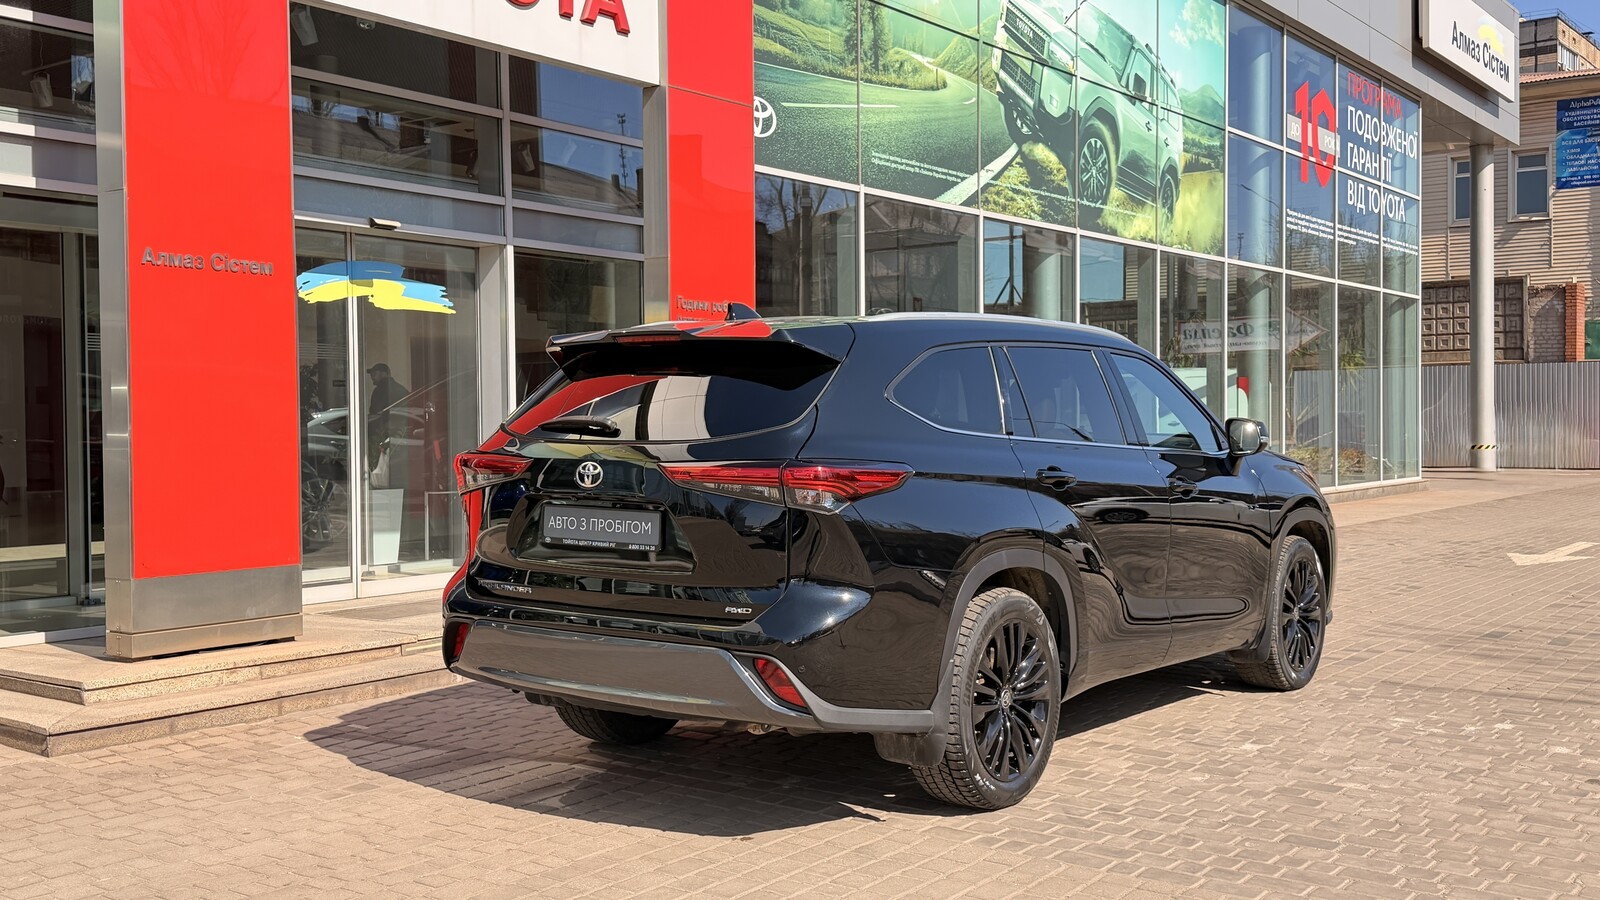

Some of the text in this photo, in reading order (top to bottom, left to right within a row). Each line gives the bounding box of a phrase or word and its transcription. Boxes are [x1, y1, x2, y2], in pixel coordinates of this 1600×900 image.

[1451, 20, 1510, 83] Алмаз Сістем
[1347, 71, 1402, 121] ПРОГРАМА
[1290, 121, 1300, 138] ДО
[1295, 81, 1336, 188] 10
[1347, 105, 1419, 160] ПОДОВЖЕНОЇ
[1347, 142, 1393, 183] ГАРАНТІЇ
[1347, 179, 1366, 215] ВІД
[141, 246, 273, 276] Алмаз Сістем
[548, 515, 577, 530] АВТО
[589, 518, 652, 535] ПРОБІГОМ
